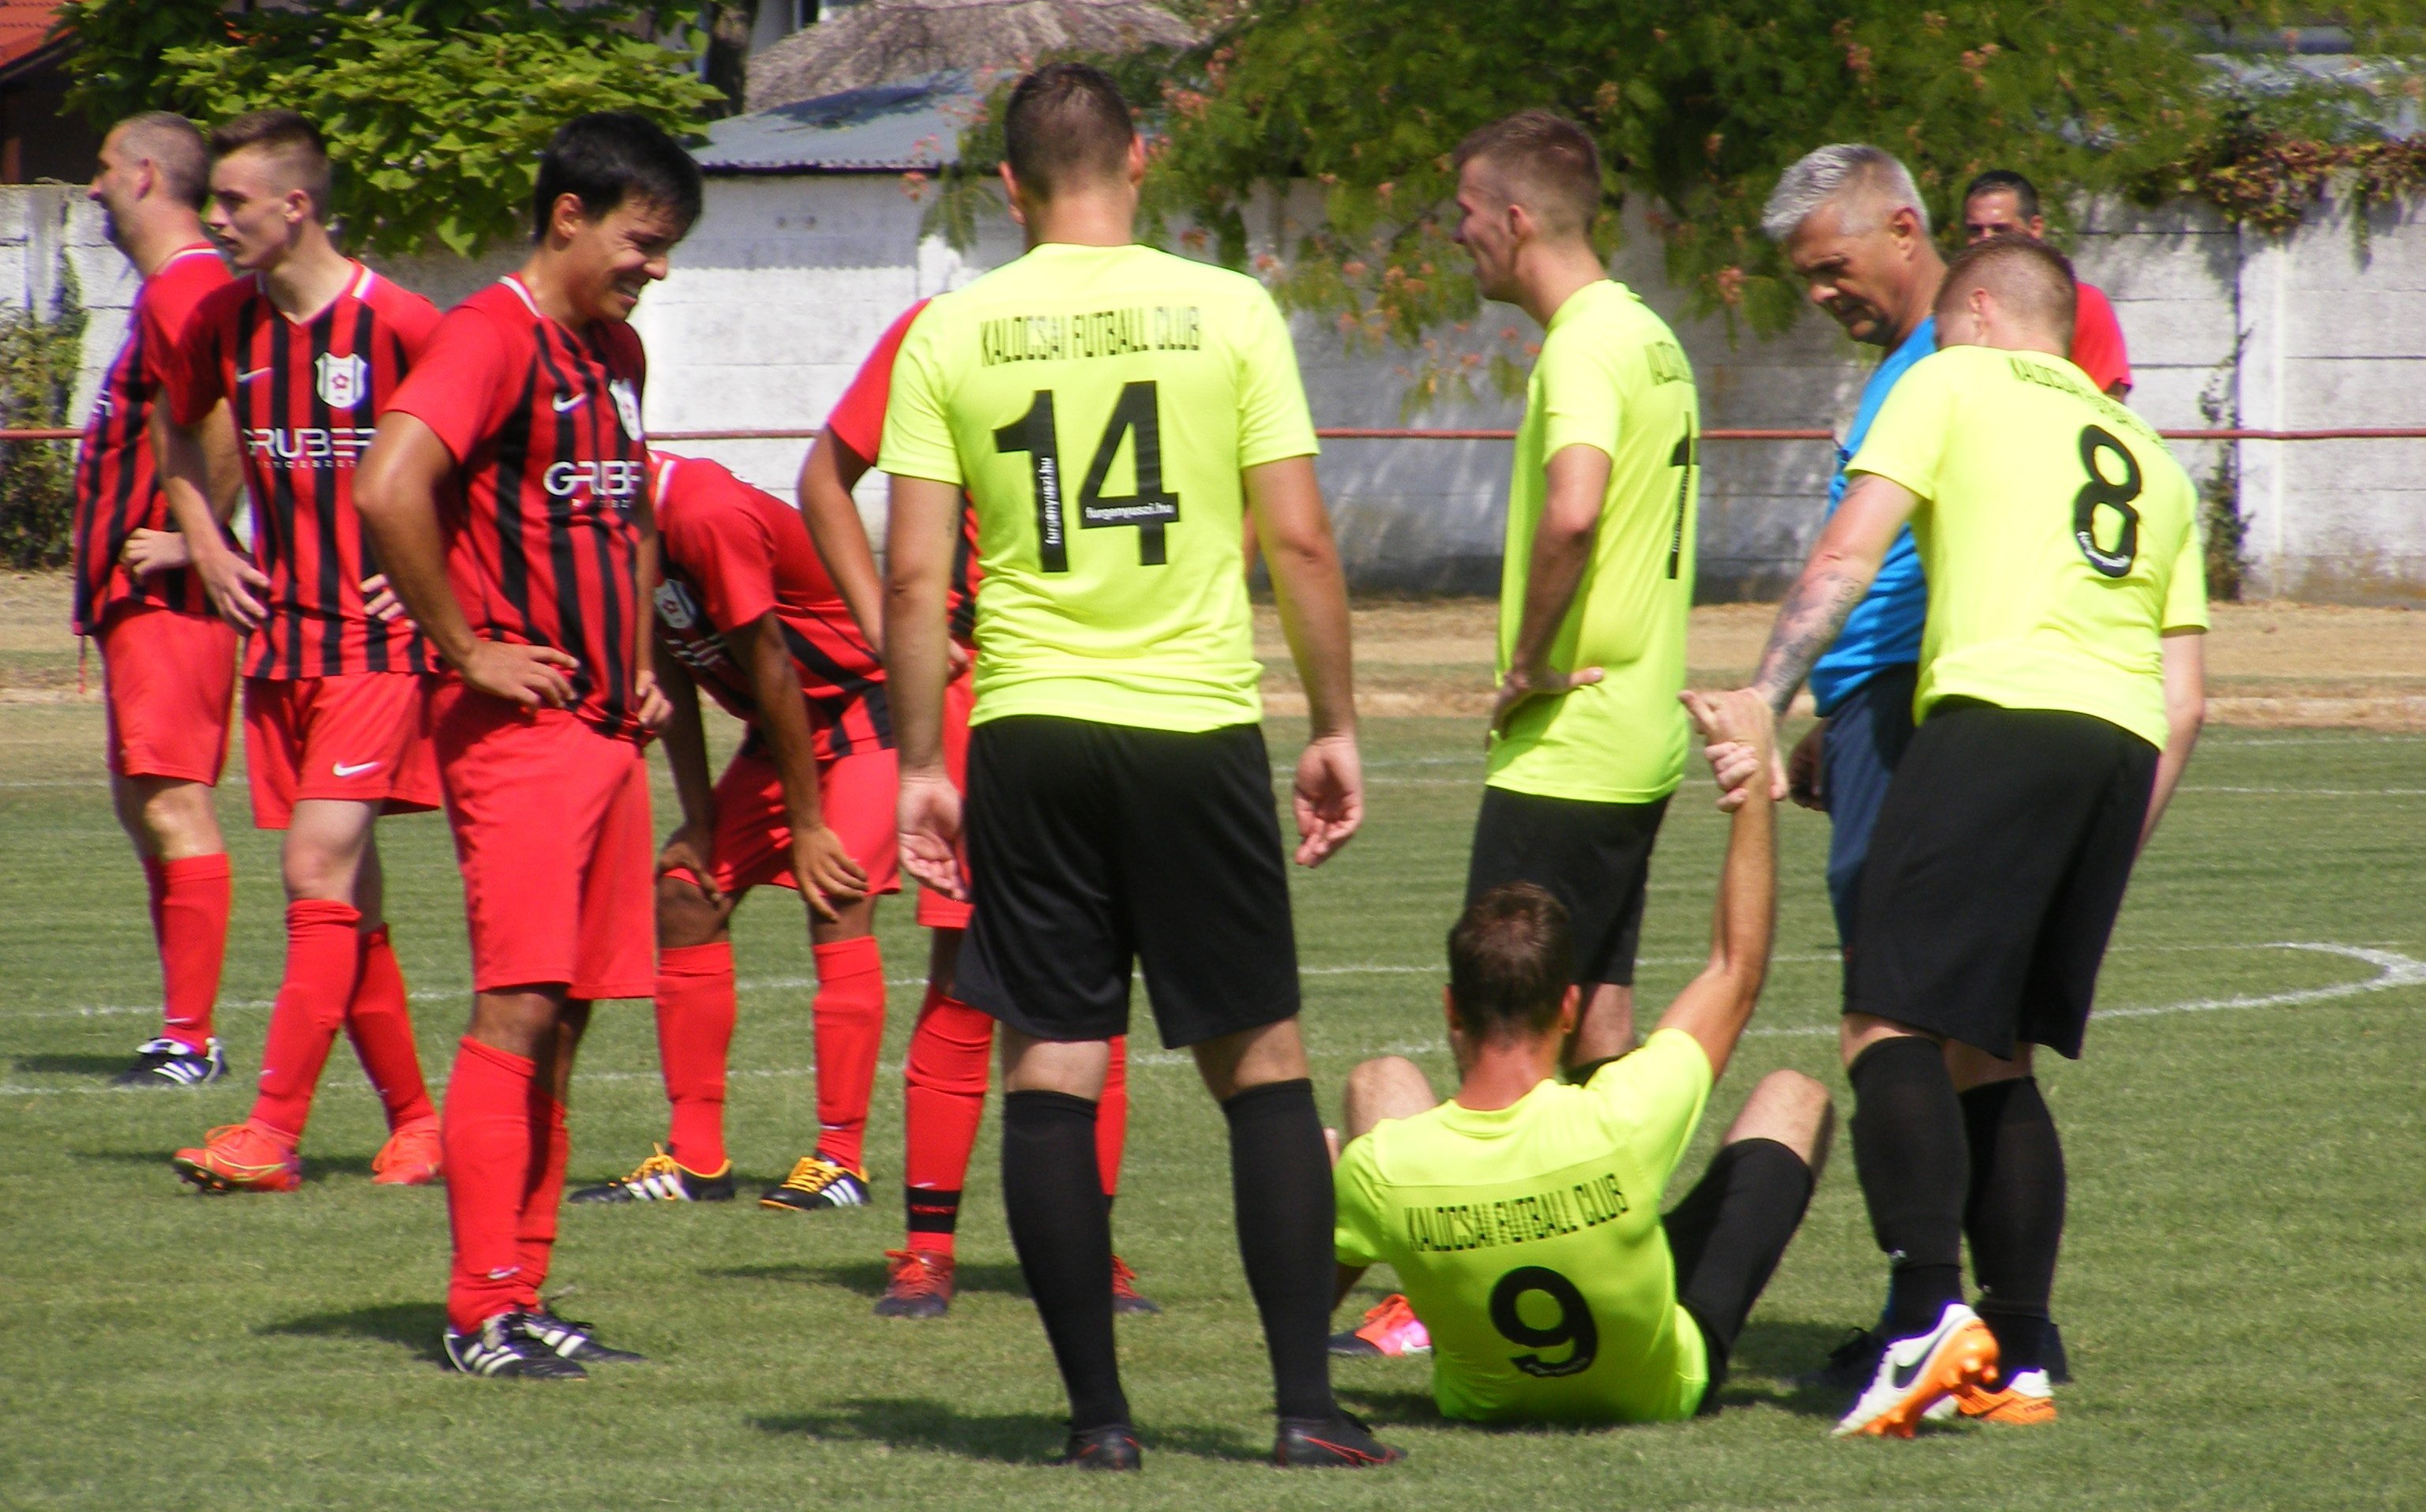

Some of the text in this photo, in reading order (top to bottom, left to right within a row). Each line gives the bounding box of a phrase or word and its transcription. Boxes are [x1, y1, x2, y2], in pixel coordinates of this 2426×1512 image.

[980, 306, 1200, 367] KALOCSAI FUTBALL CLUB
[992, 380, 1181, 572] 14
[2071, 422, 2142, 579] 8
[1404, 1172, 1629, 1252] KALOCSAI FUTBALL CLUB
[1489, 1265, 1598, 1379] 9
